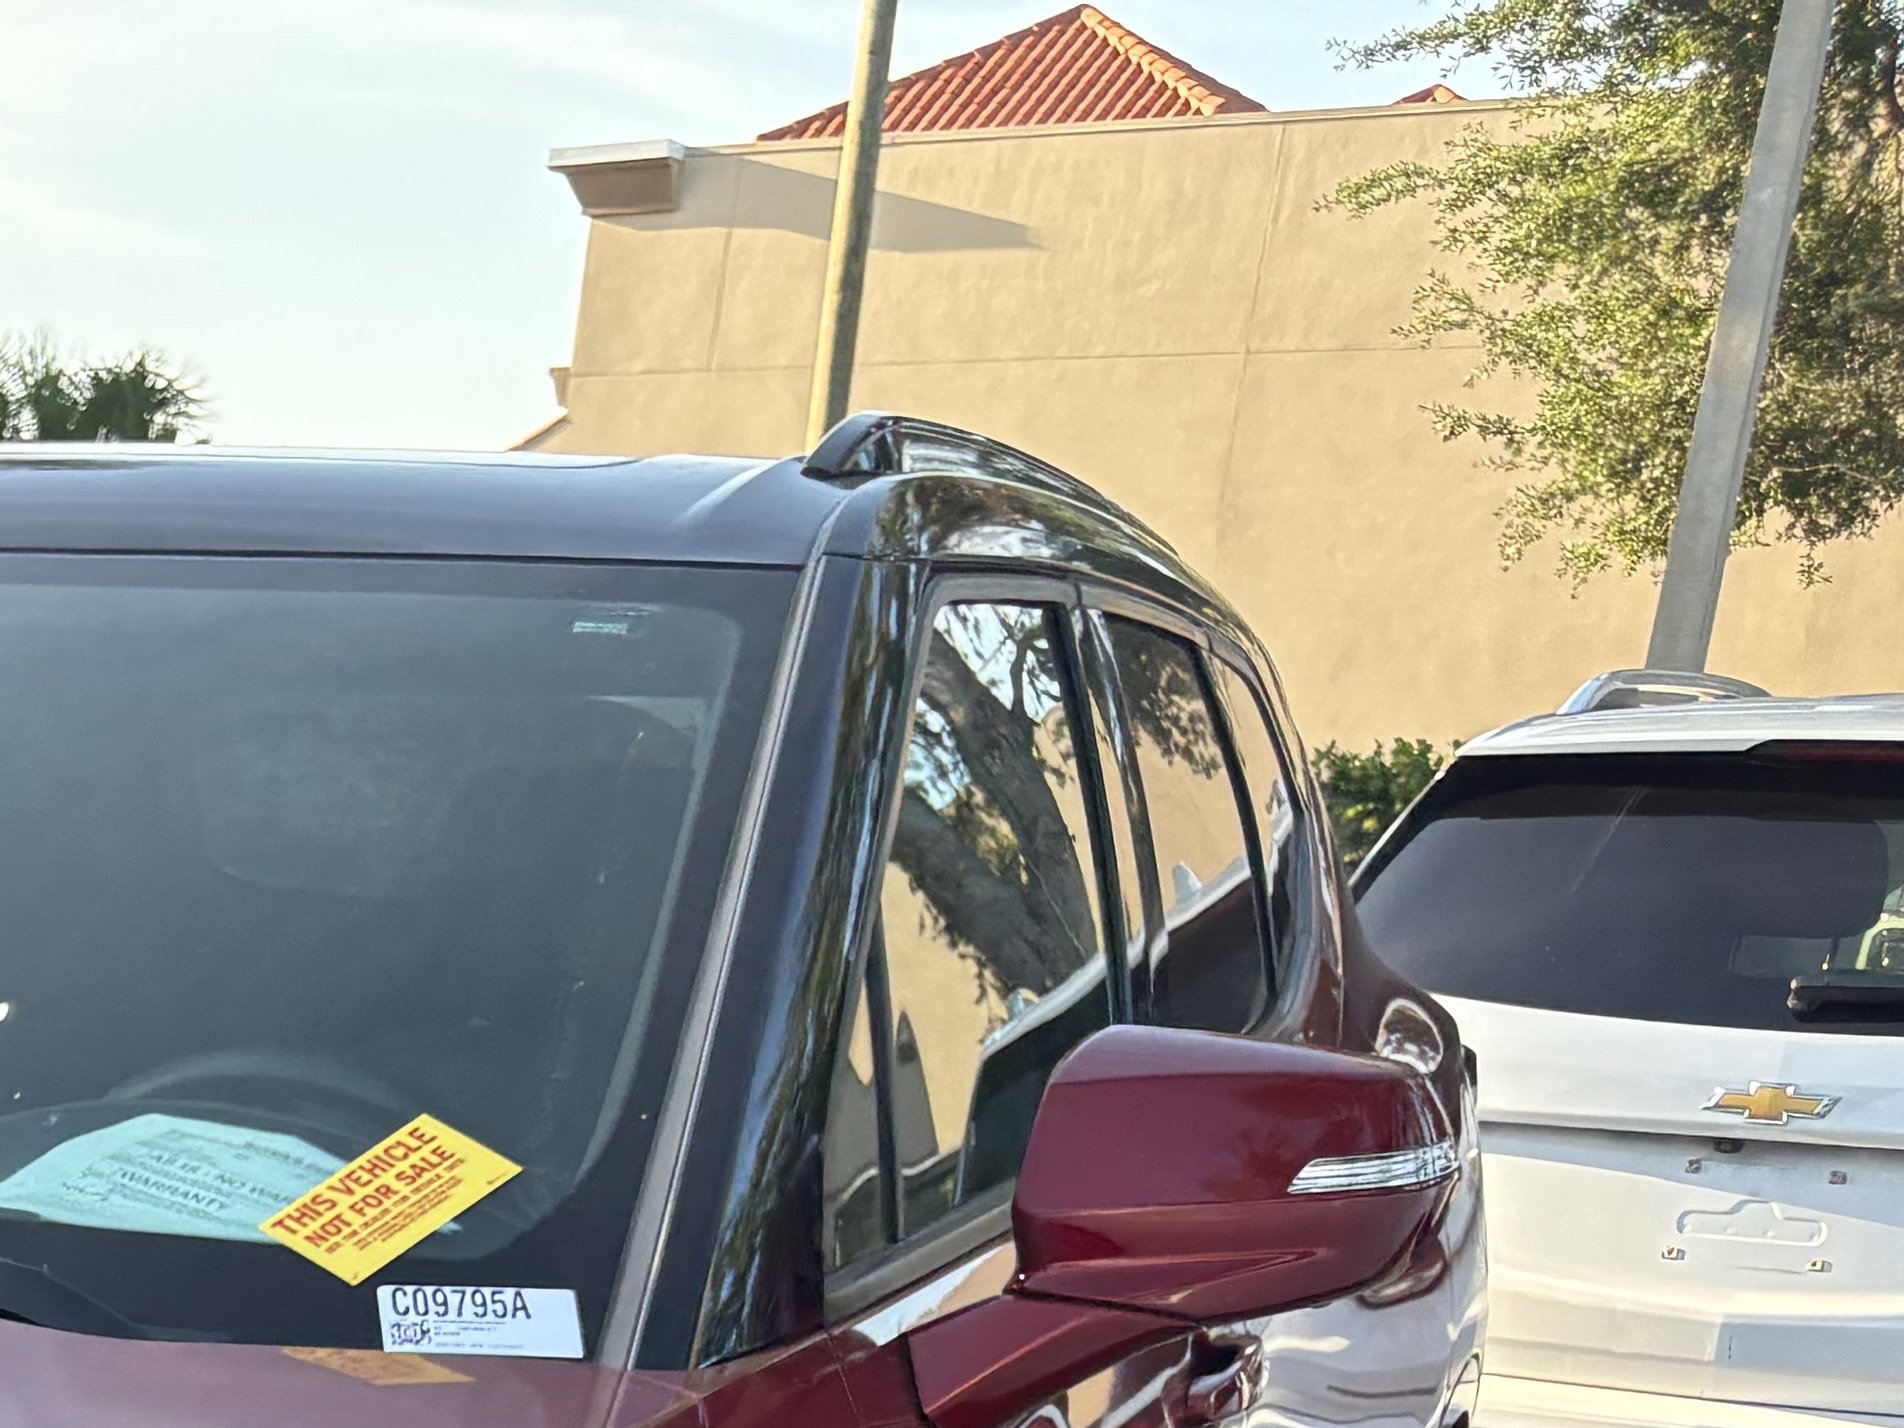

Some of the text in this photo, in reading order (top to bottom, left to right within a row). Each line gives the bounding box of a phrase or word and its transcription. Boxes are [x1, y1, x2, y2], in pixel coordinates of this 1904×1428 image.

[271, 1192, 338, 1235] THIS
[326, 1126, 438, 1200] VEHICLE
[304, 1213, 353, 1248] NOT
[348, 1183, 398, 1217] FOR
[394, 1145, 455, 1187] SALE
[392, 1287, 532, 1320] C09795A
